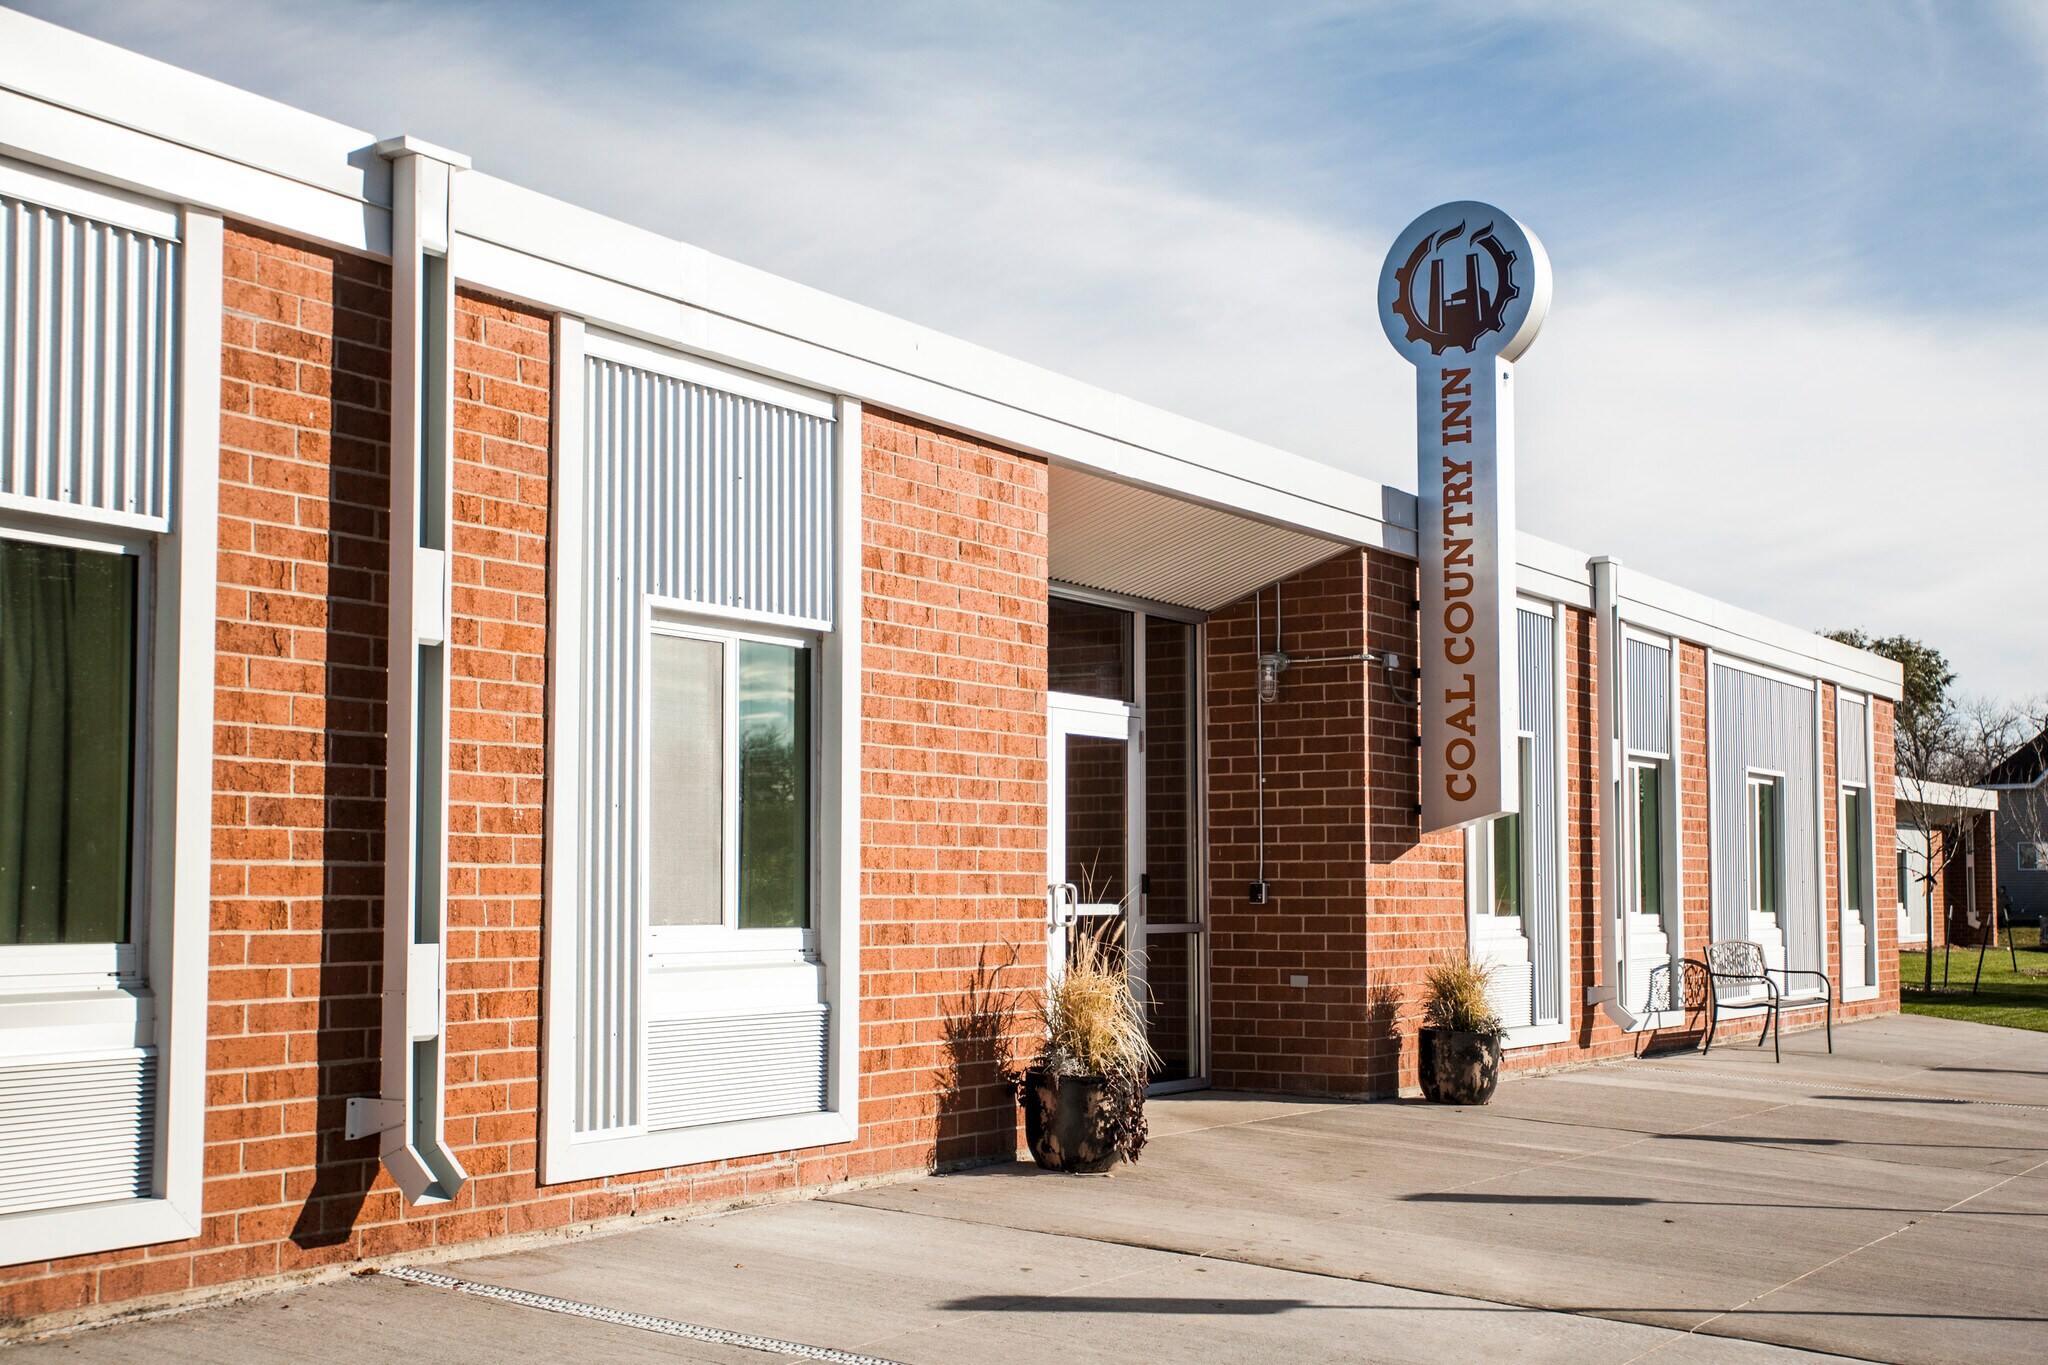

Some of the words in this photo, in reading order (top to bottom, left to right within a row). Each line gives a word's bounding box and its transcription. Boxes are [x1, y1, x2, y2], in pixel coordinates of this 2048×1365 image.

[1441, 368, 1472, 446] INN
[1443, 456, 1475, 665] COUNTRY
[1445, 674, 1477, 802] COAL
